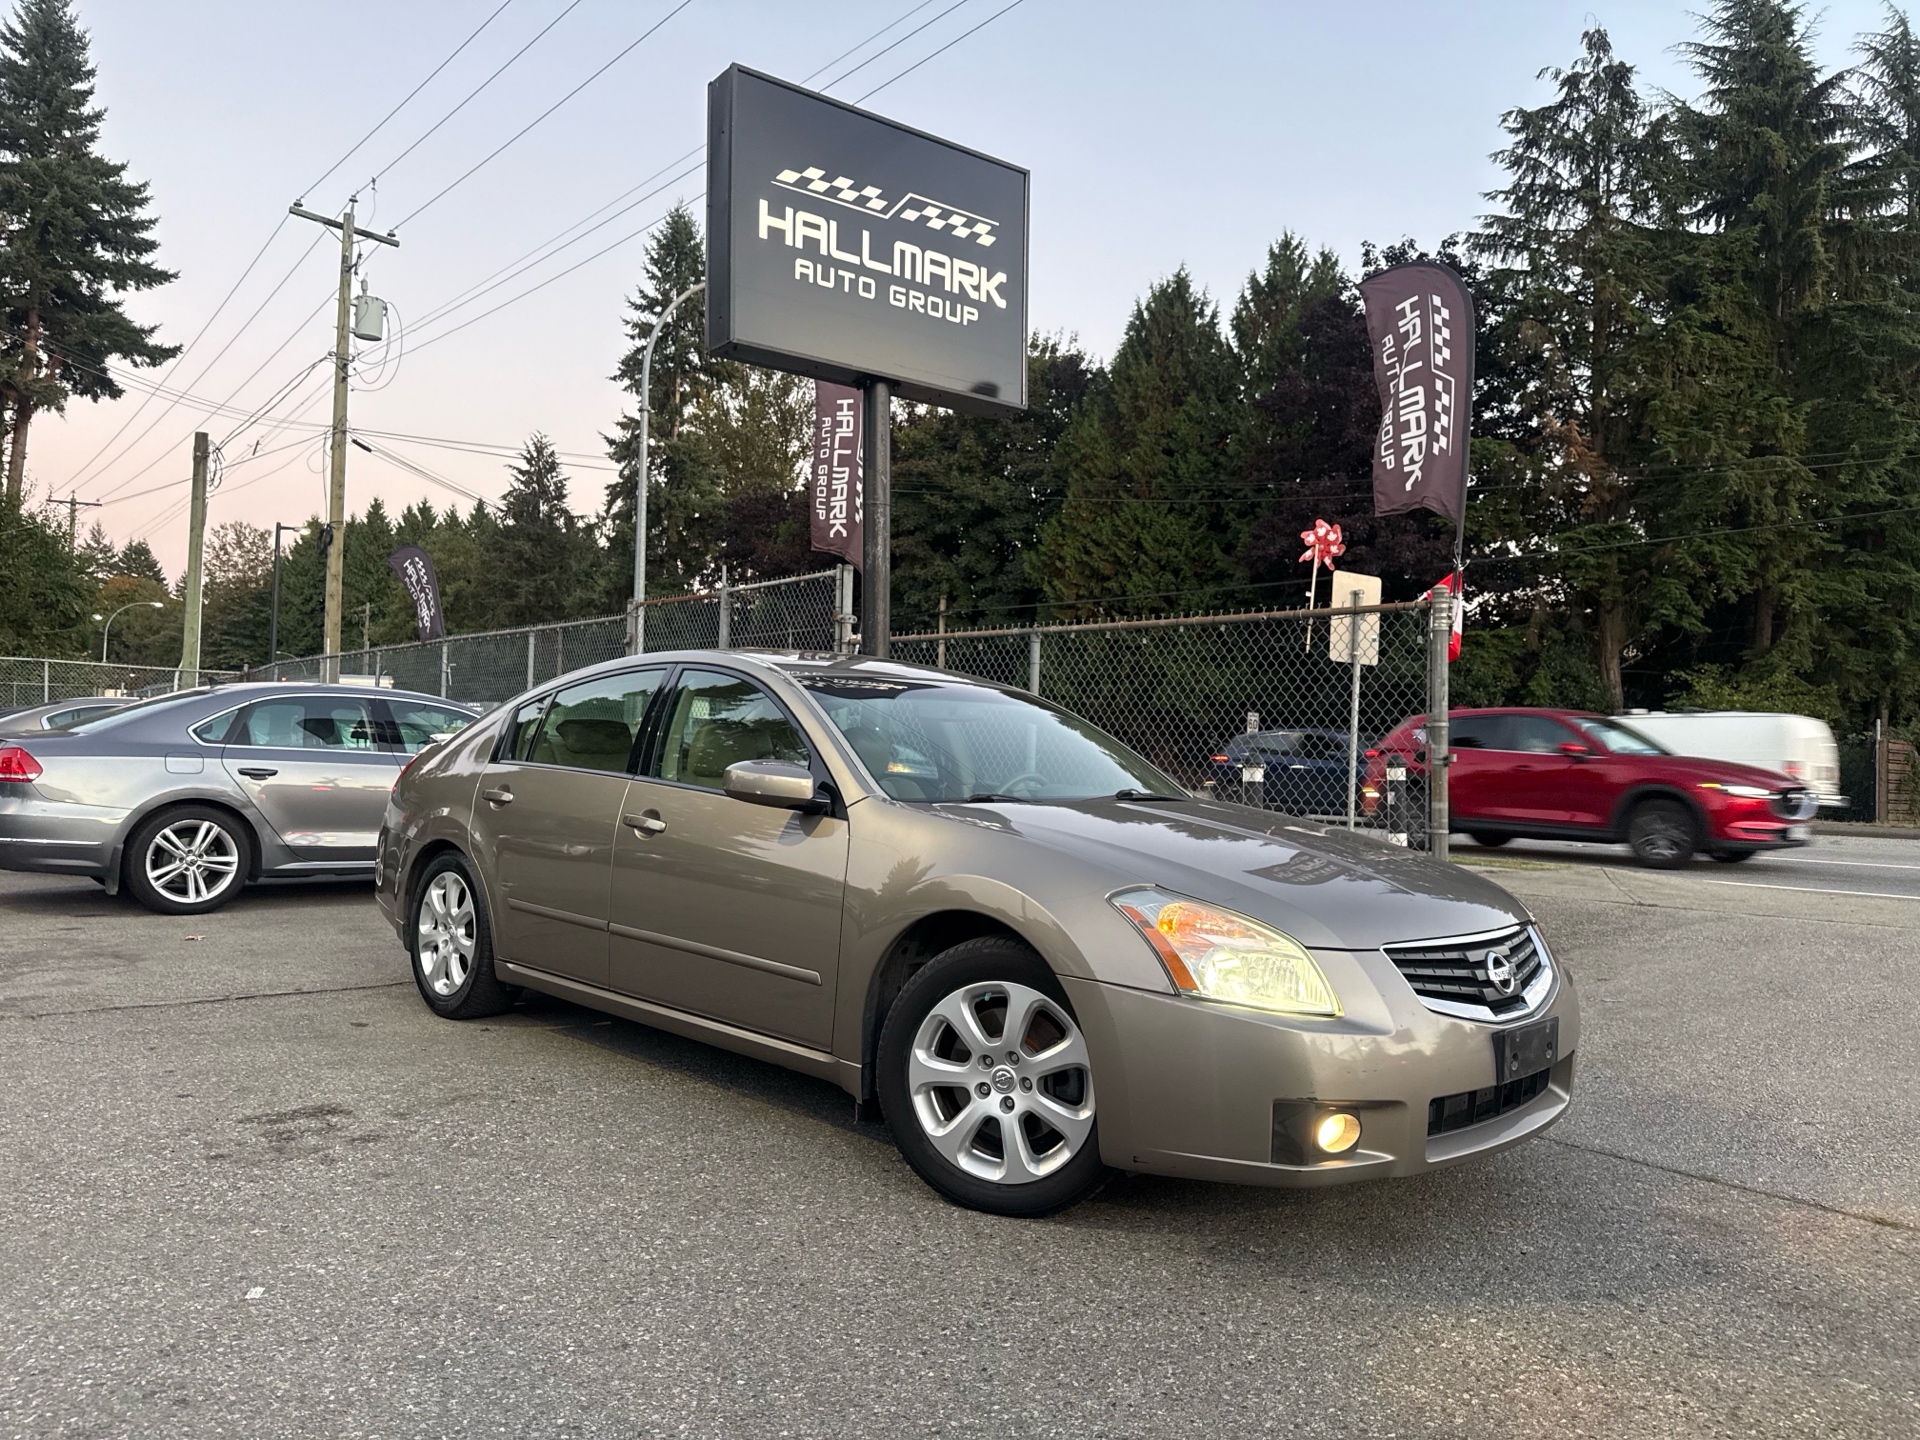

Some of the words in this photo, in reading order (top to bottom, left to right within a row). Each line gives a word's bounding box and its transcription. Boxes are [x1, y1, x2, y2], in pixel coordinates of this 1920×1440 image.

[758, 198, 1008, 310] HALLMARK
[794, 257, 876, 300] AUTO
[888, 284, 979, 327] GROUP
[819, 416, 832, 459] AUTO
[1395, 294, 1428, 492] HALLMARK
[815, 464, 829, 521] GROUP
[829, 398, 854, 538] HALLMARK
